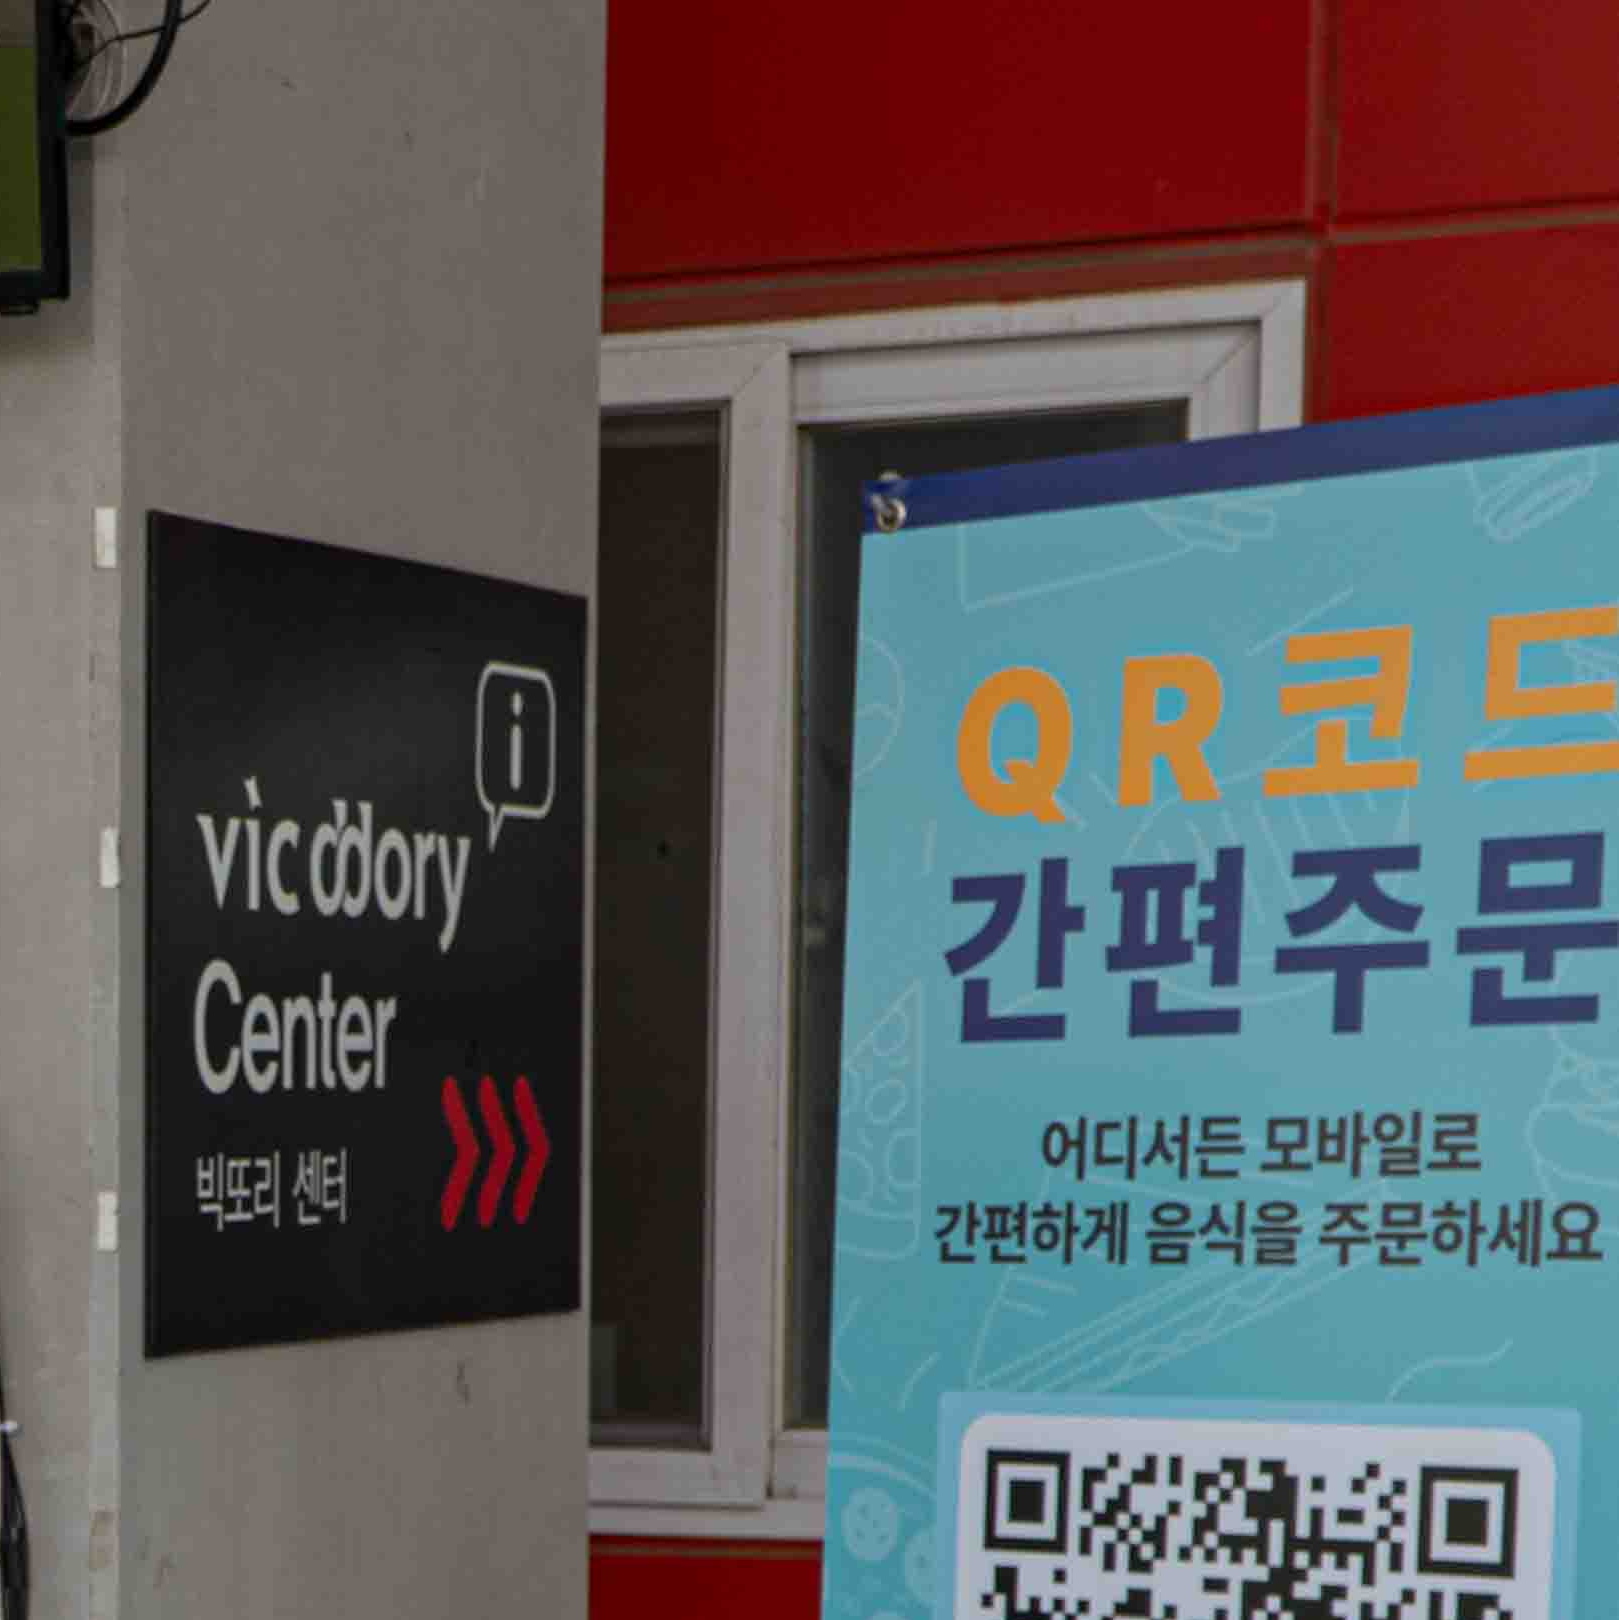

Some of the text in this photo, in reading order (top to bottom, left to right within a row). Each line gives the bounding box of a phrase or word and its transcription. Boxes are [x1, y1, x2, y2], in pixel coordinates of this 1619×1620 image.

[955, 607, 1619, 824] QR코드
[943, 832, 1619, 1044] 간편주문
[194, 959, 397, 1095] Center
[196, 1148, 349, 1232] 빅또리 센터
[1042, 1111, 1482, 1181] 어디서든 모바일로
[934, 1200, 1604, 1268] 간편하게 음식을 주문하세요
